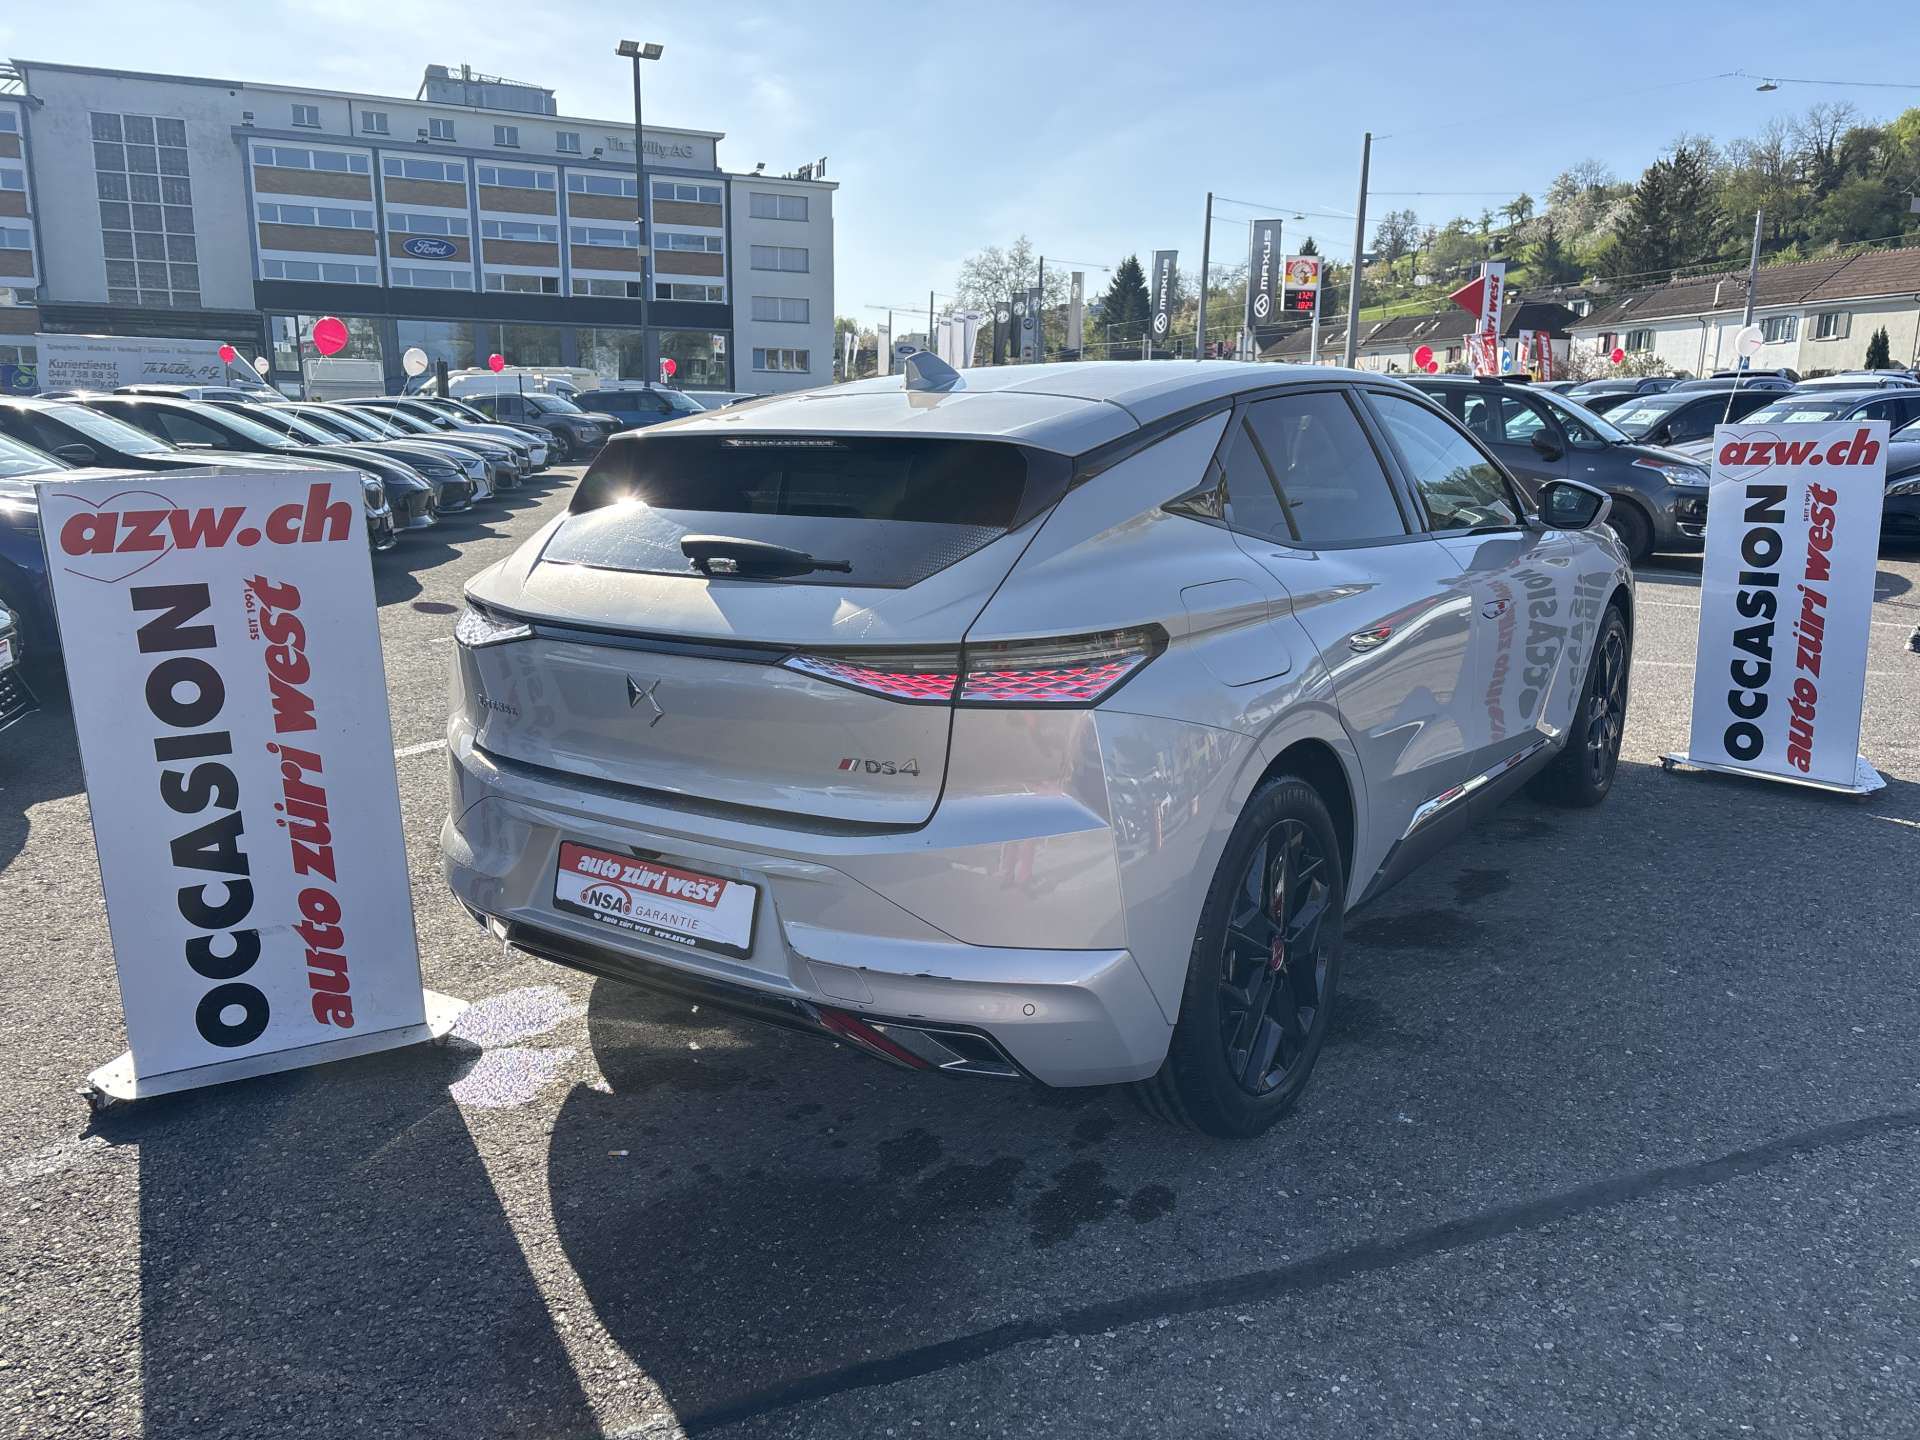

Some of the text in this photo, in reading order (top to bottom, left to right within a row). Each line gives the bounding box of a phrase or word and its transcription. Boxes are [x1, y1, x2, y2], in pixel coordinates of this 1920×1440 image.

[671, 144, 693, 159] AG
[1488, 273, 1500, 312] west
[49, 358, 117, 371] Kurierdienst
[198, 366, 221, 379] AG
[1719, 428, 1880, 467] azw.ch
[60, 483, 352, 555] azw.ch
[243, 588, 260, 641] SEIT 1991
[1723, 484, 1788, 762] OCCASION
[1787, 482, 1838, 774] auto züri west
[131, 582, 270, 1048] OCCASION
[243, 574, 355, 1029] auto züri west
[577, 855, 721, 903] auto züri west
[588, 890, 700, 930] NSA GARANTIE
